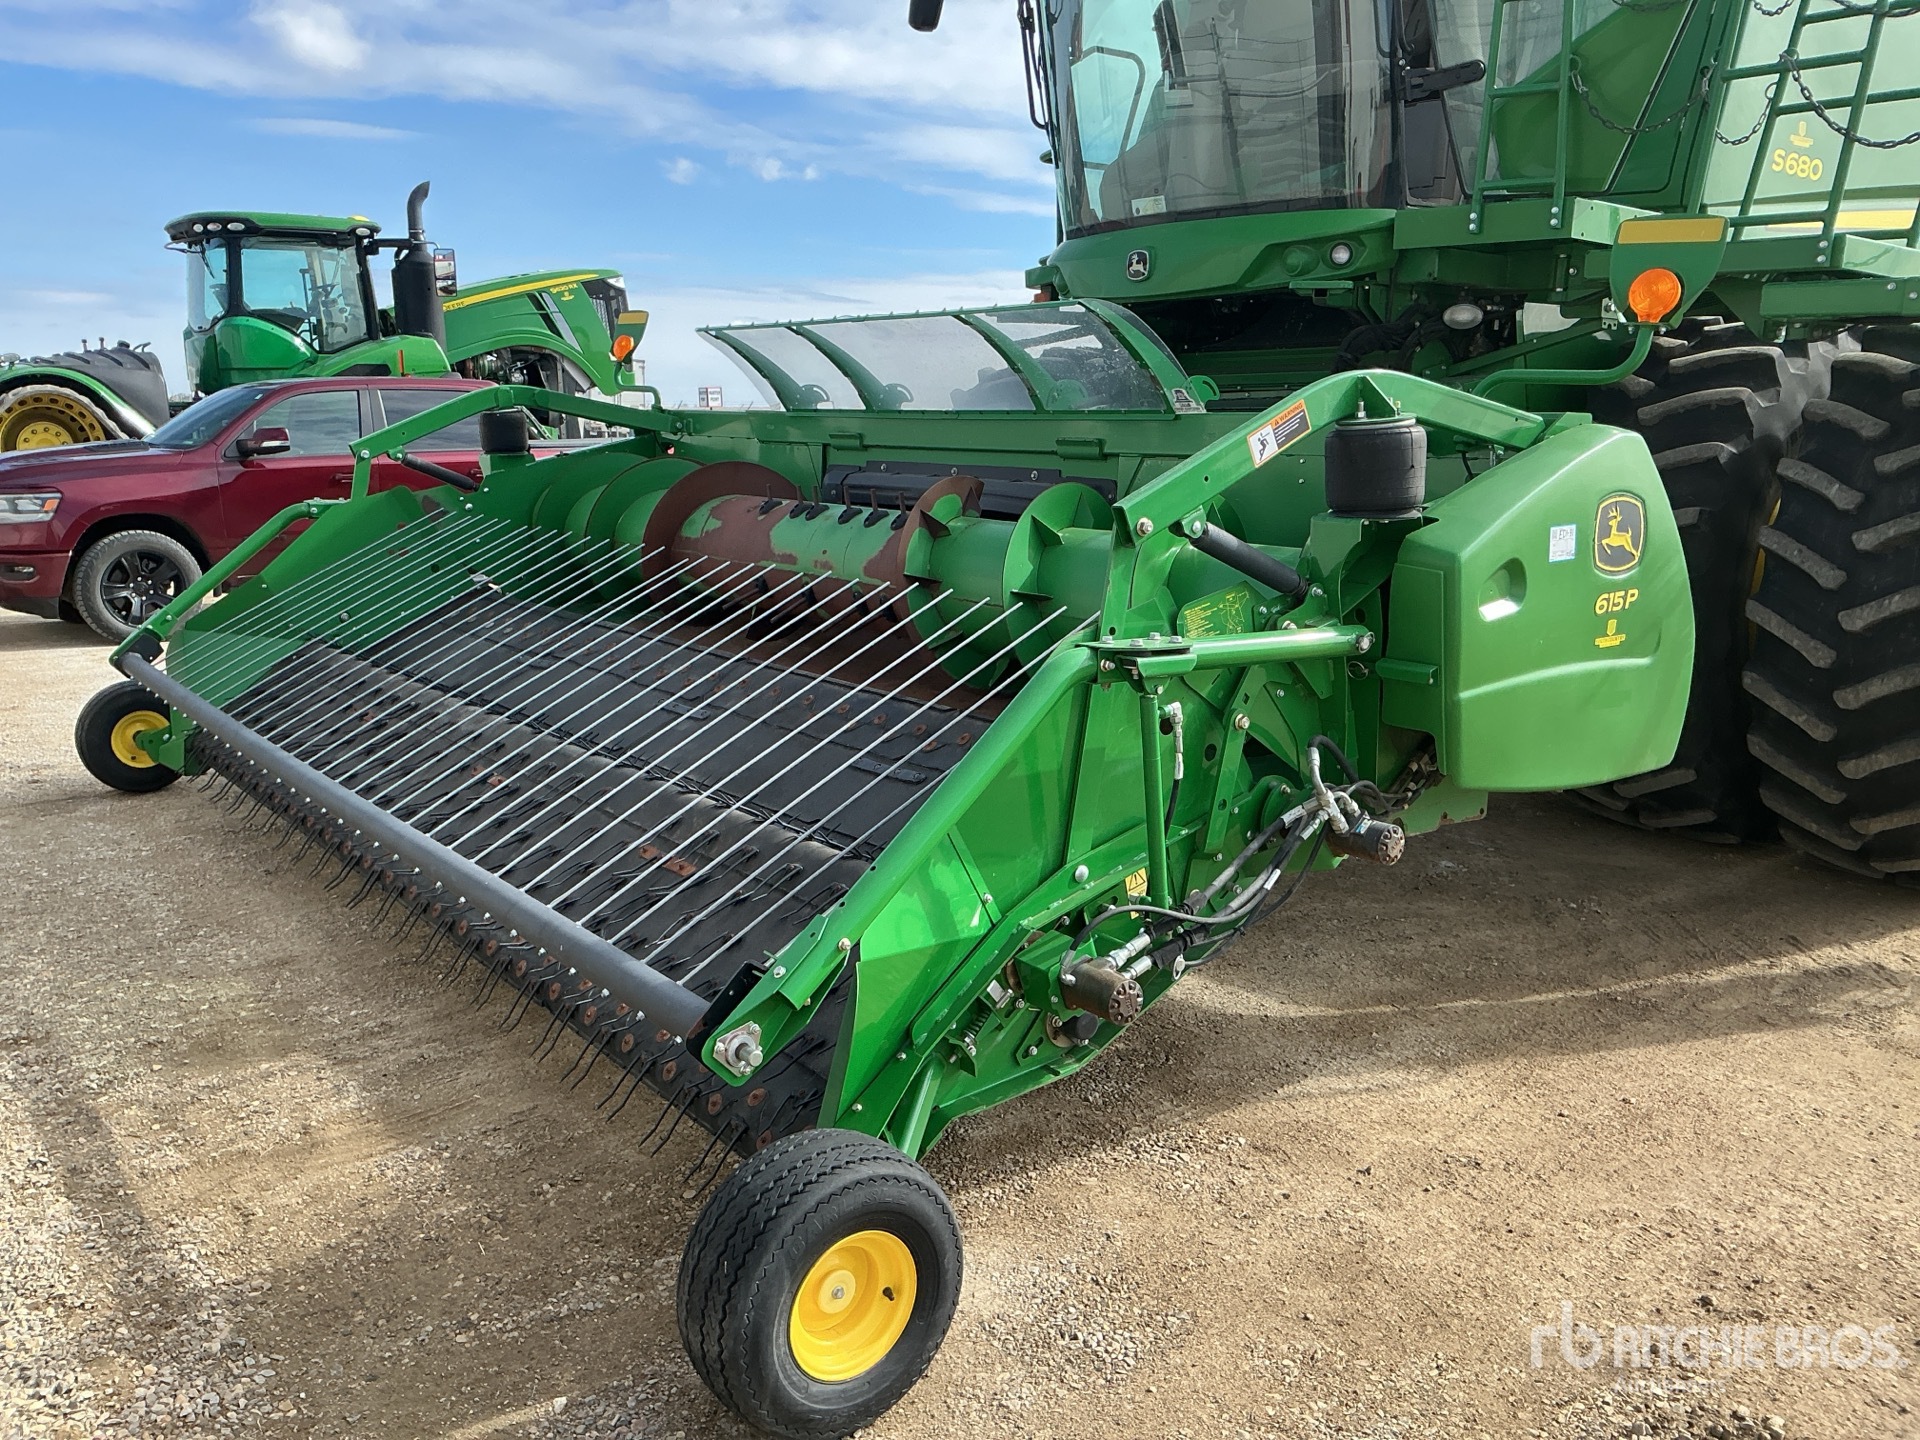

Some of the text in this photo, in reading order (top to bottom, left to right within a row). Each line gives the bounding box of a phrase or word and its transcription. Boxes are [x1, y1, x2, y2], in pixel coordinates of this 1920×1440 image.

[1771, 148, 1823, 181] S680
[1279, 402, 1303, 421] WARNING
[1594, 588, 1639, 615] 615P
[788, 1187, 909, 1260] CARLISLE
